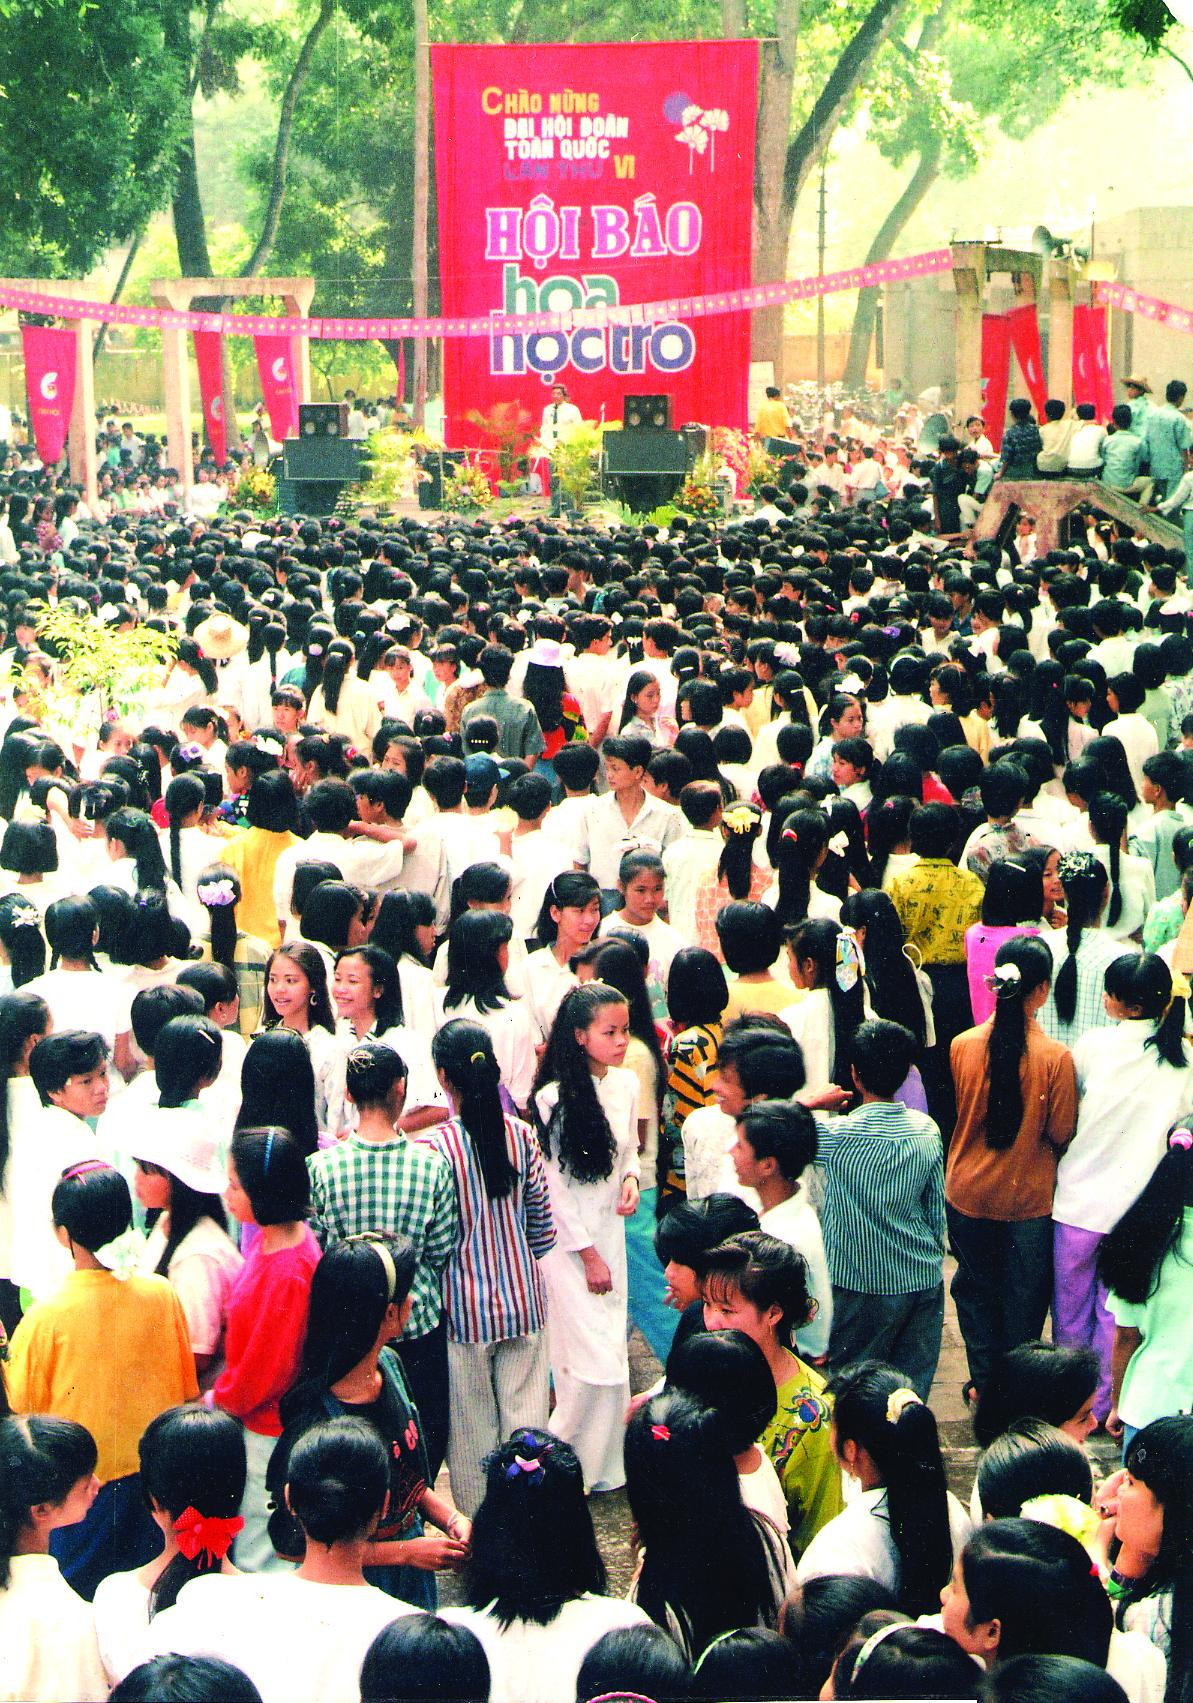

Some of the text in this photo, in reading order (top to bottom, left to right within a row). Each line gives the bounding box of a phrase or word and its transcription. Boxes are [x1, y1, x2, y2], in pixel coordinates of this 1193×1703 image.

[481, 86, 543, 115] CHÀO
[541, 114, 573, 140] HỘI
[504, 136, 610, 161] TOÀN QUỐC
[613, 155, 636, 179] VI
[485, 192, 702, 270] HỘI BÁO
[502, 263, 620, 316] hoa
